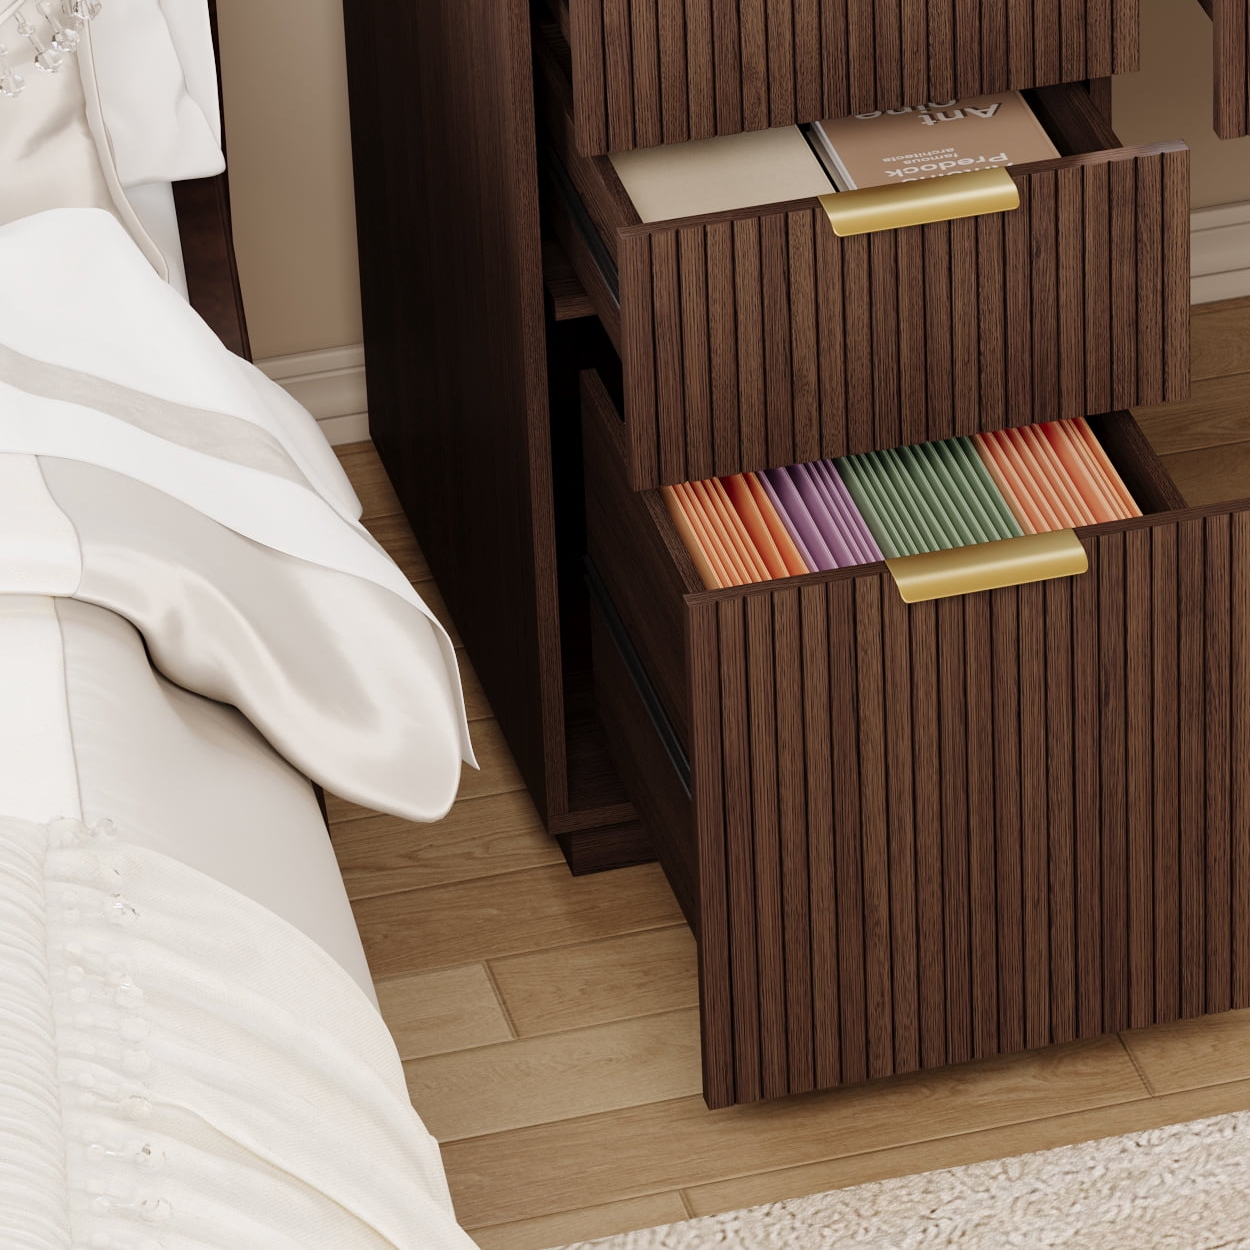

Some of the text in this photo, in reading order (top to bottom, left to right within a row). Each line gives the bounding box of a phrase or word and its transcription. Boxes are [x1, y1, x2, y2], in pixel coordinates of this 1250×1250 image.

[917, 103, 999, 126] Ant
[884, 152, 1009, 177] Predock
[903, 152, 958, 165] famous
